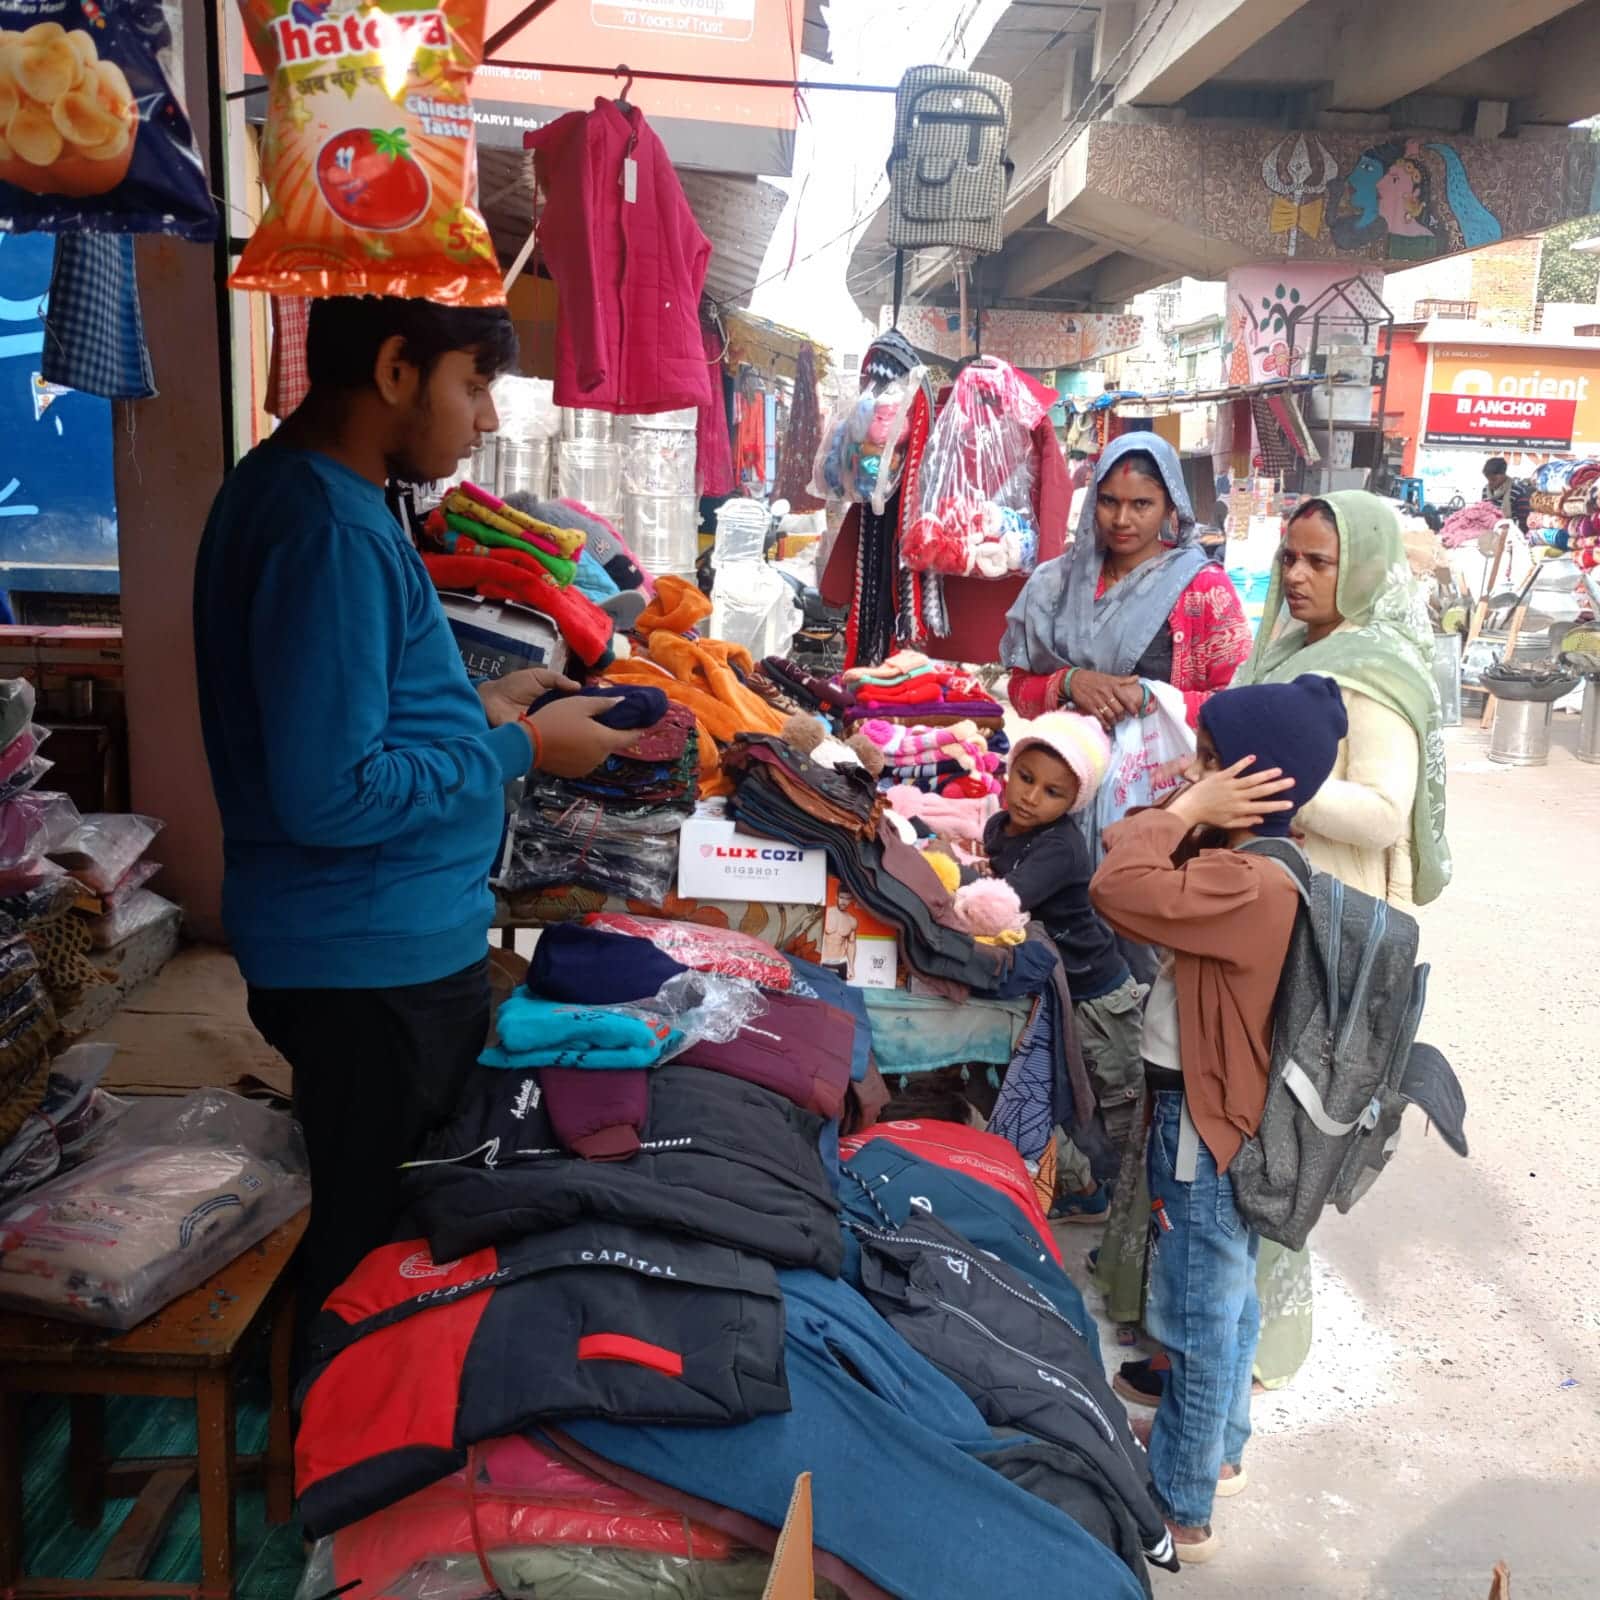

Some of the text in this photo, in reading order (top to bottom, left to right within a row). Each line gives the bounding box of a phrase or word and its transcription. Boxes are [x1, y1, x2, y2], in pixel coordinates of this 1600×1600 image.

[639, 11, 673, 29] Years
[678, 15, 691, 29] of
[693, 17, 724, 33] Trust
[473, 112, 510, 127] KARVI
[513, 116, 538, 129] Mob
[1499, 370, 1589, 401] orient
[1473, 400, 1547, 416] ANCHOR
[716, 847, 804, 862] LUX COZI
[724, 865, 780, 877] BIGSHOT
[581, 1250, 678, 1277] CAPITAL
[417, 1266, 511, 1303] CLASSIC
